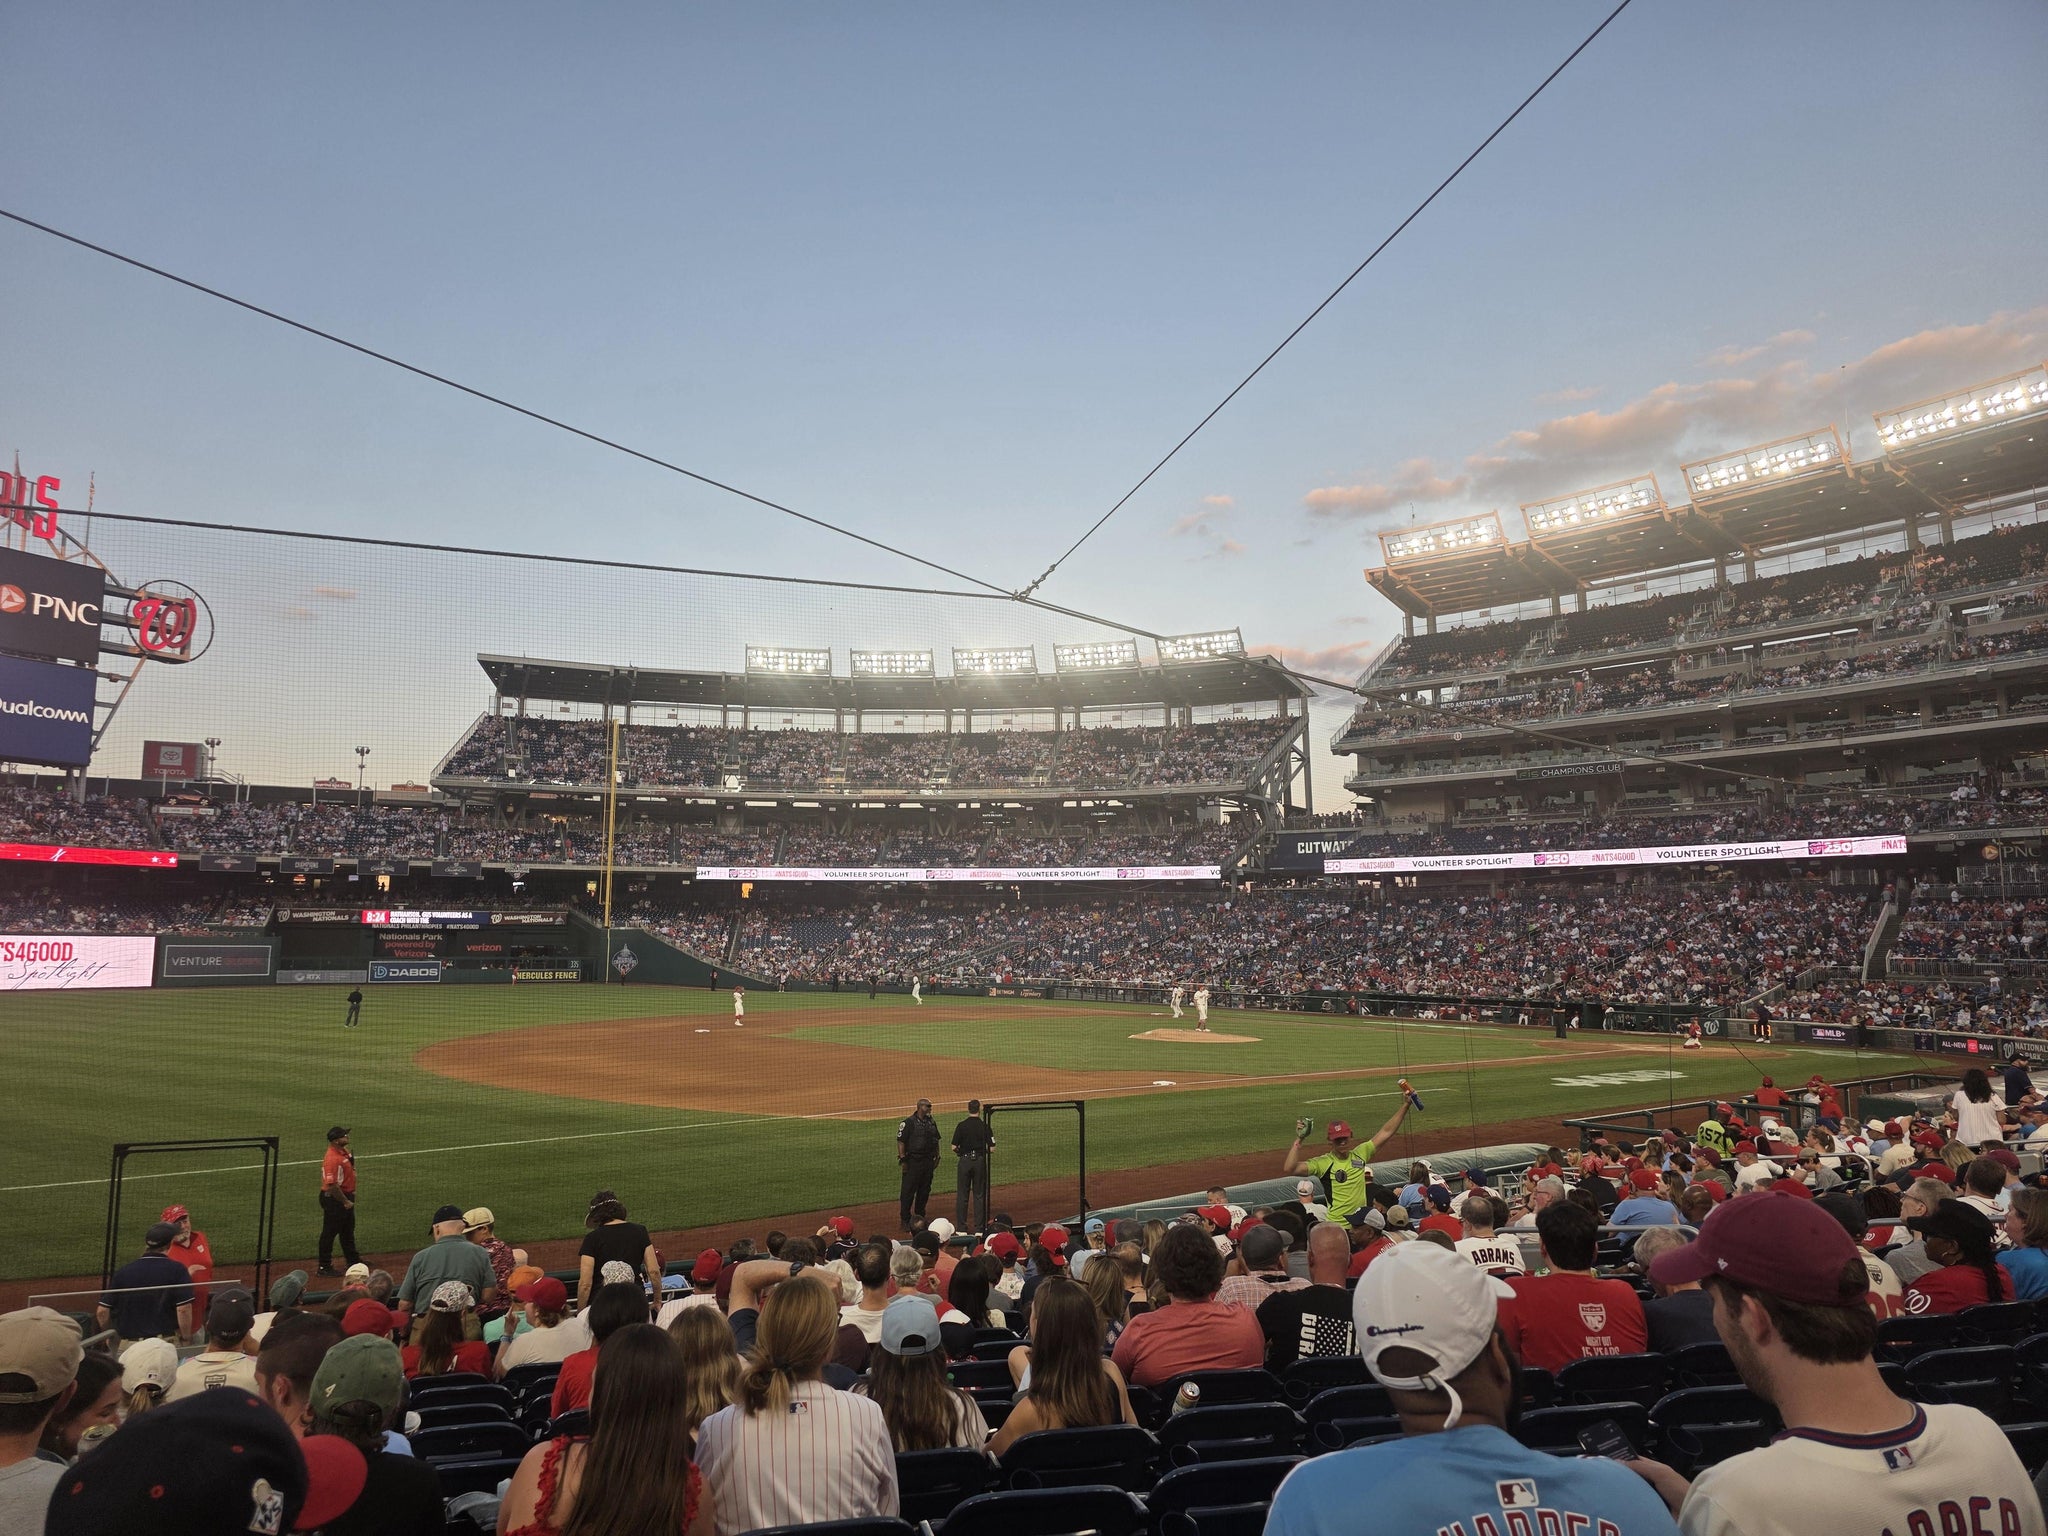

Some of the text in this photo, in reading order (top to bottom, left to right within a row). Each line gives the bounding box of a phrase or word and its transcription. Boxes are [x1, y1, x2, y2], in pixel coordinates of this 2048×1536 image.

[31, 592, 98, 626] PNC
[153, 767, 187, 776] TOYOTA
[1541, 765, 1594, 777] CHAMPIONS
[1596, 763, 1620, 773] CLUB
[1297, 840, 1354, 854] CUTWAT
[1656, 849, 1719, 860] VOLUNTEER
[1720, 845, 1781, 857] SPOTLIGHT
[1359, 861, 1395, 869] #NATS4GOOD
[1412, 859, 1463, 868] VOLUNTEER
[1465, 857, 1513, 867] SPOTLIGHT
[1546, 854, 1569, 865] 250
[1592, 852, 1636, 862] #NATS4GOOD
[366, 911, 386, 922] 8:24
[385, 941, 436, 950] powered by
[394, 949, 427, 958] Verizon
[171, 956, 222, 967] VENTURE
[389, 968, 438, 977] DABOS
[517, 971, 577, 980] HERCULES FENCE
[1825, 1029, 1845, 1037] MLB+
[1942, 1040, 1994, 1051] ALL-NEW RAV4
[1699, 1125, 1722, 1145] 257
[1471, 1247, 1515, 1265] ABRAMS
[1366, 1322, 1425, 1337] Champion
[1581, 1346, 1593, 1358] 15
